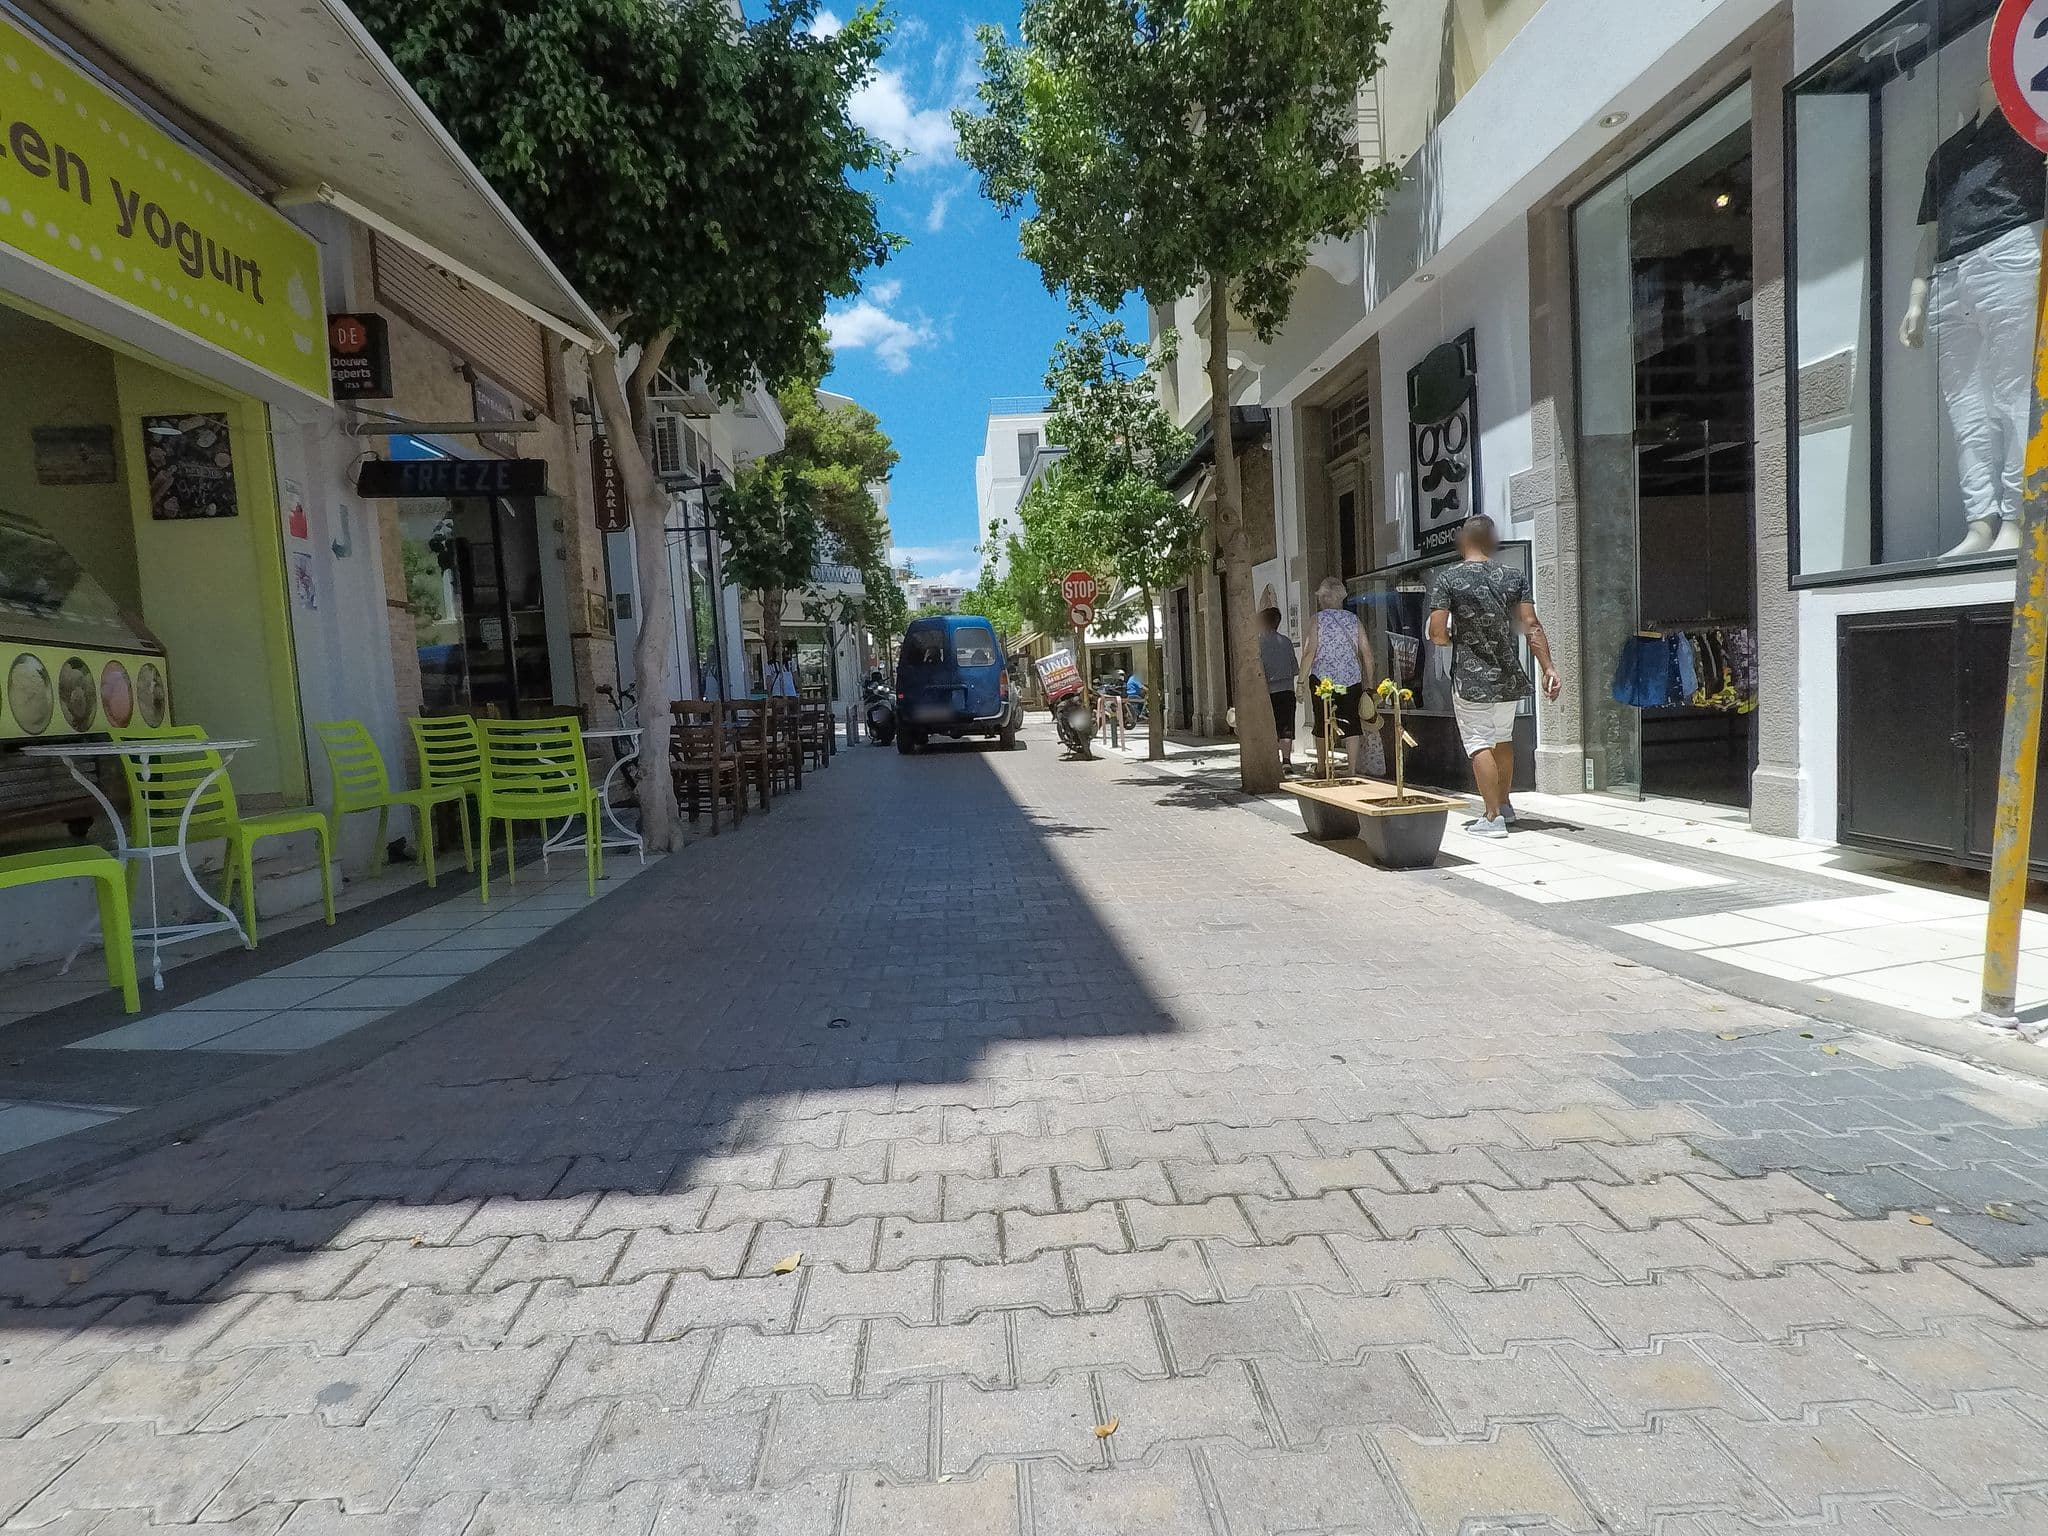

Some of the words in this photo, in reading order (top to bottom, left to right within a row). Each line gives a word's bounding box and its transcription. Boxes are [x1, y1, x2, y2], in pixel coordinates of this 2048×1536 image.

[0, 115, 92, 205] en
[109, 176, 265, 305] yogurt
[332, 358, 369, 367] Douwe
[331, 368, 371, 381] Egberts
[402, 461, 512, 490] FREEZE
[1064, 580, 1095, 599] STOP
[1039, 656, 1071, 675] UNO
